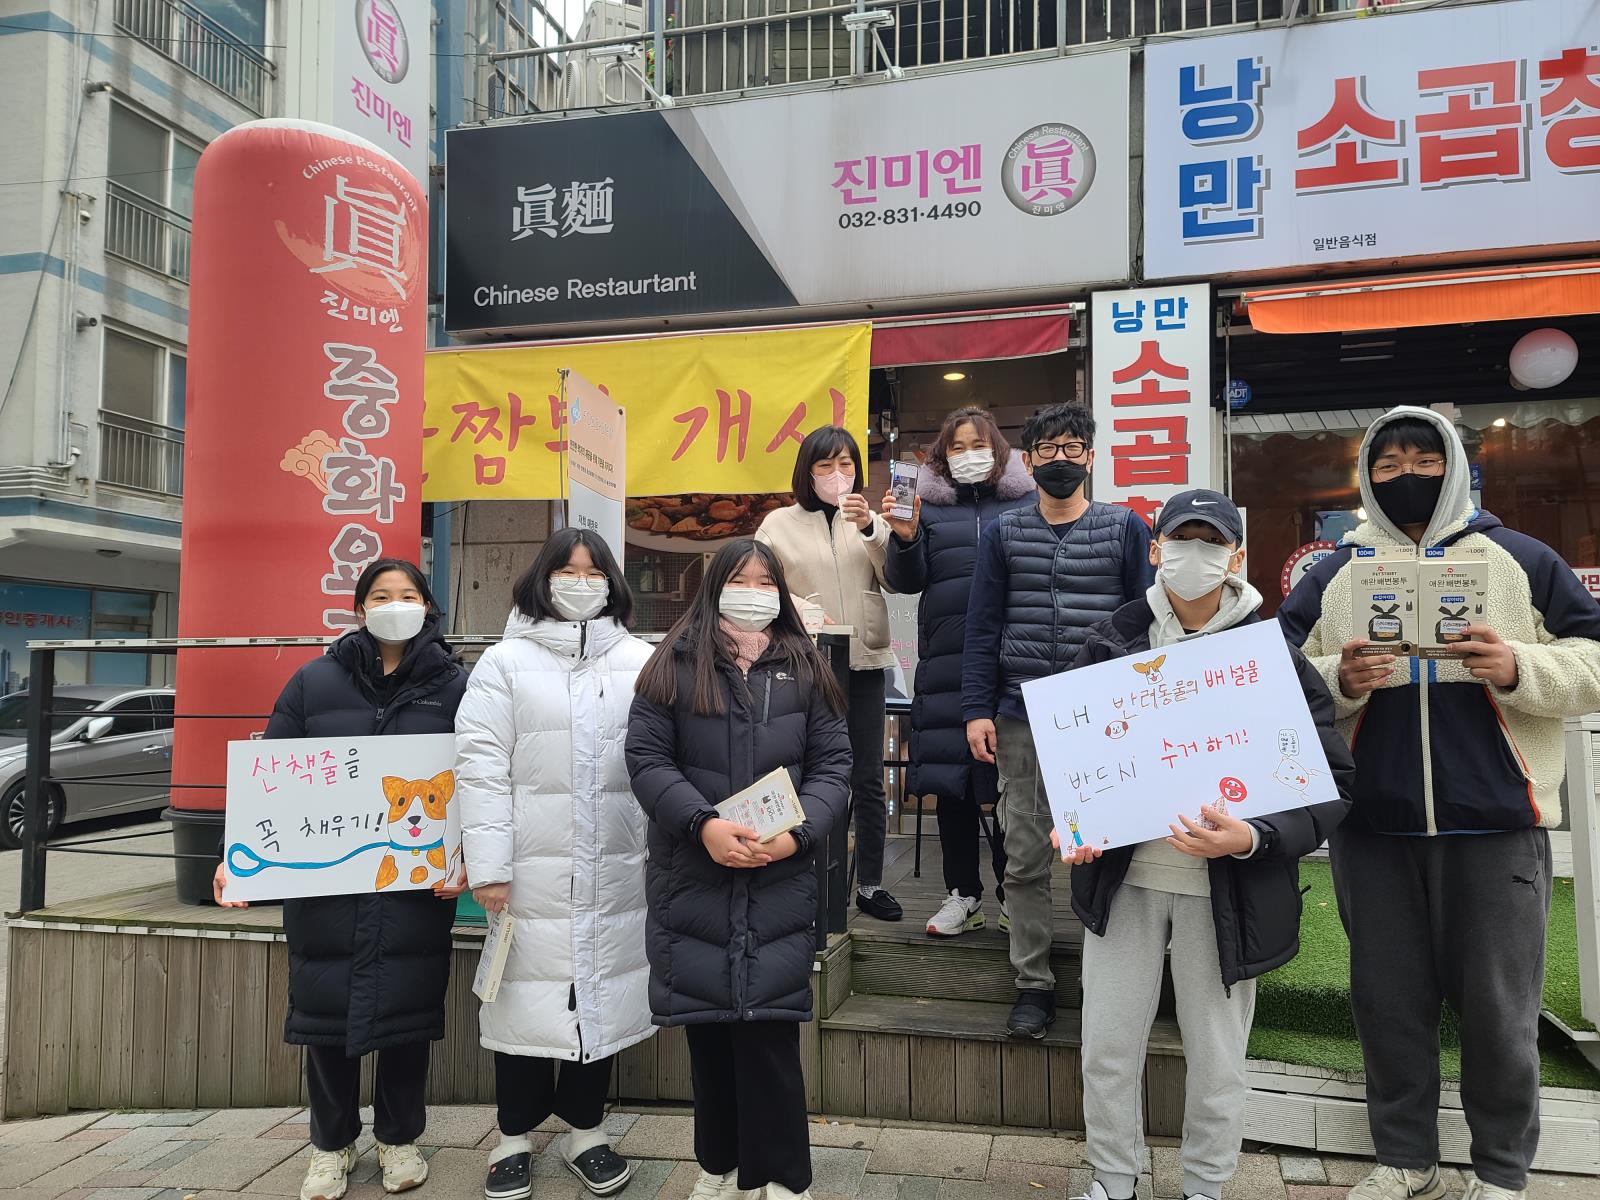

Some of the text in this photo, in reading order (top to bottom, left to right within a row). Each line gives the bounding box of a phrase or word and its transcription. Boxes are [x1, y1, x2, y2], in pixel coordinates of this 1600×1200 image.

[351, 75, 412, 149] 진미엔
[1008, 130, 1040, 159] Chinese
[1179, 57, 1266, 242] 낭만
[302, 154, 418, 214] Chinese Restaurant
[831, 144, 982, 206] 진미엔
[1312, 231, 1378, 252] 일반음식점
[473, 270, 697, 307] Chinese Restaurtant
[319, 289, 404, 334] 진미엔
[1111, 296, 1189, 334] 낭만
[1110, 340, 1192, 528] 소곱
[1053, 705, 1091, 731] 내
[1111, 679, 1200, 720] 반려동물의
[251, 748, 360, 794] 산책줄을
[1067, 760, 1137, 804] 반드시
[255, 812, 385, 853] 꼭 채우기!
